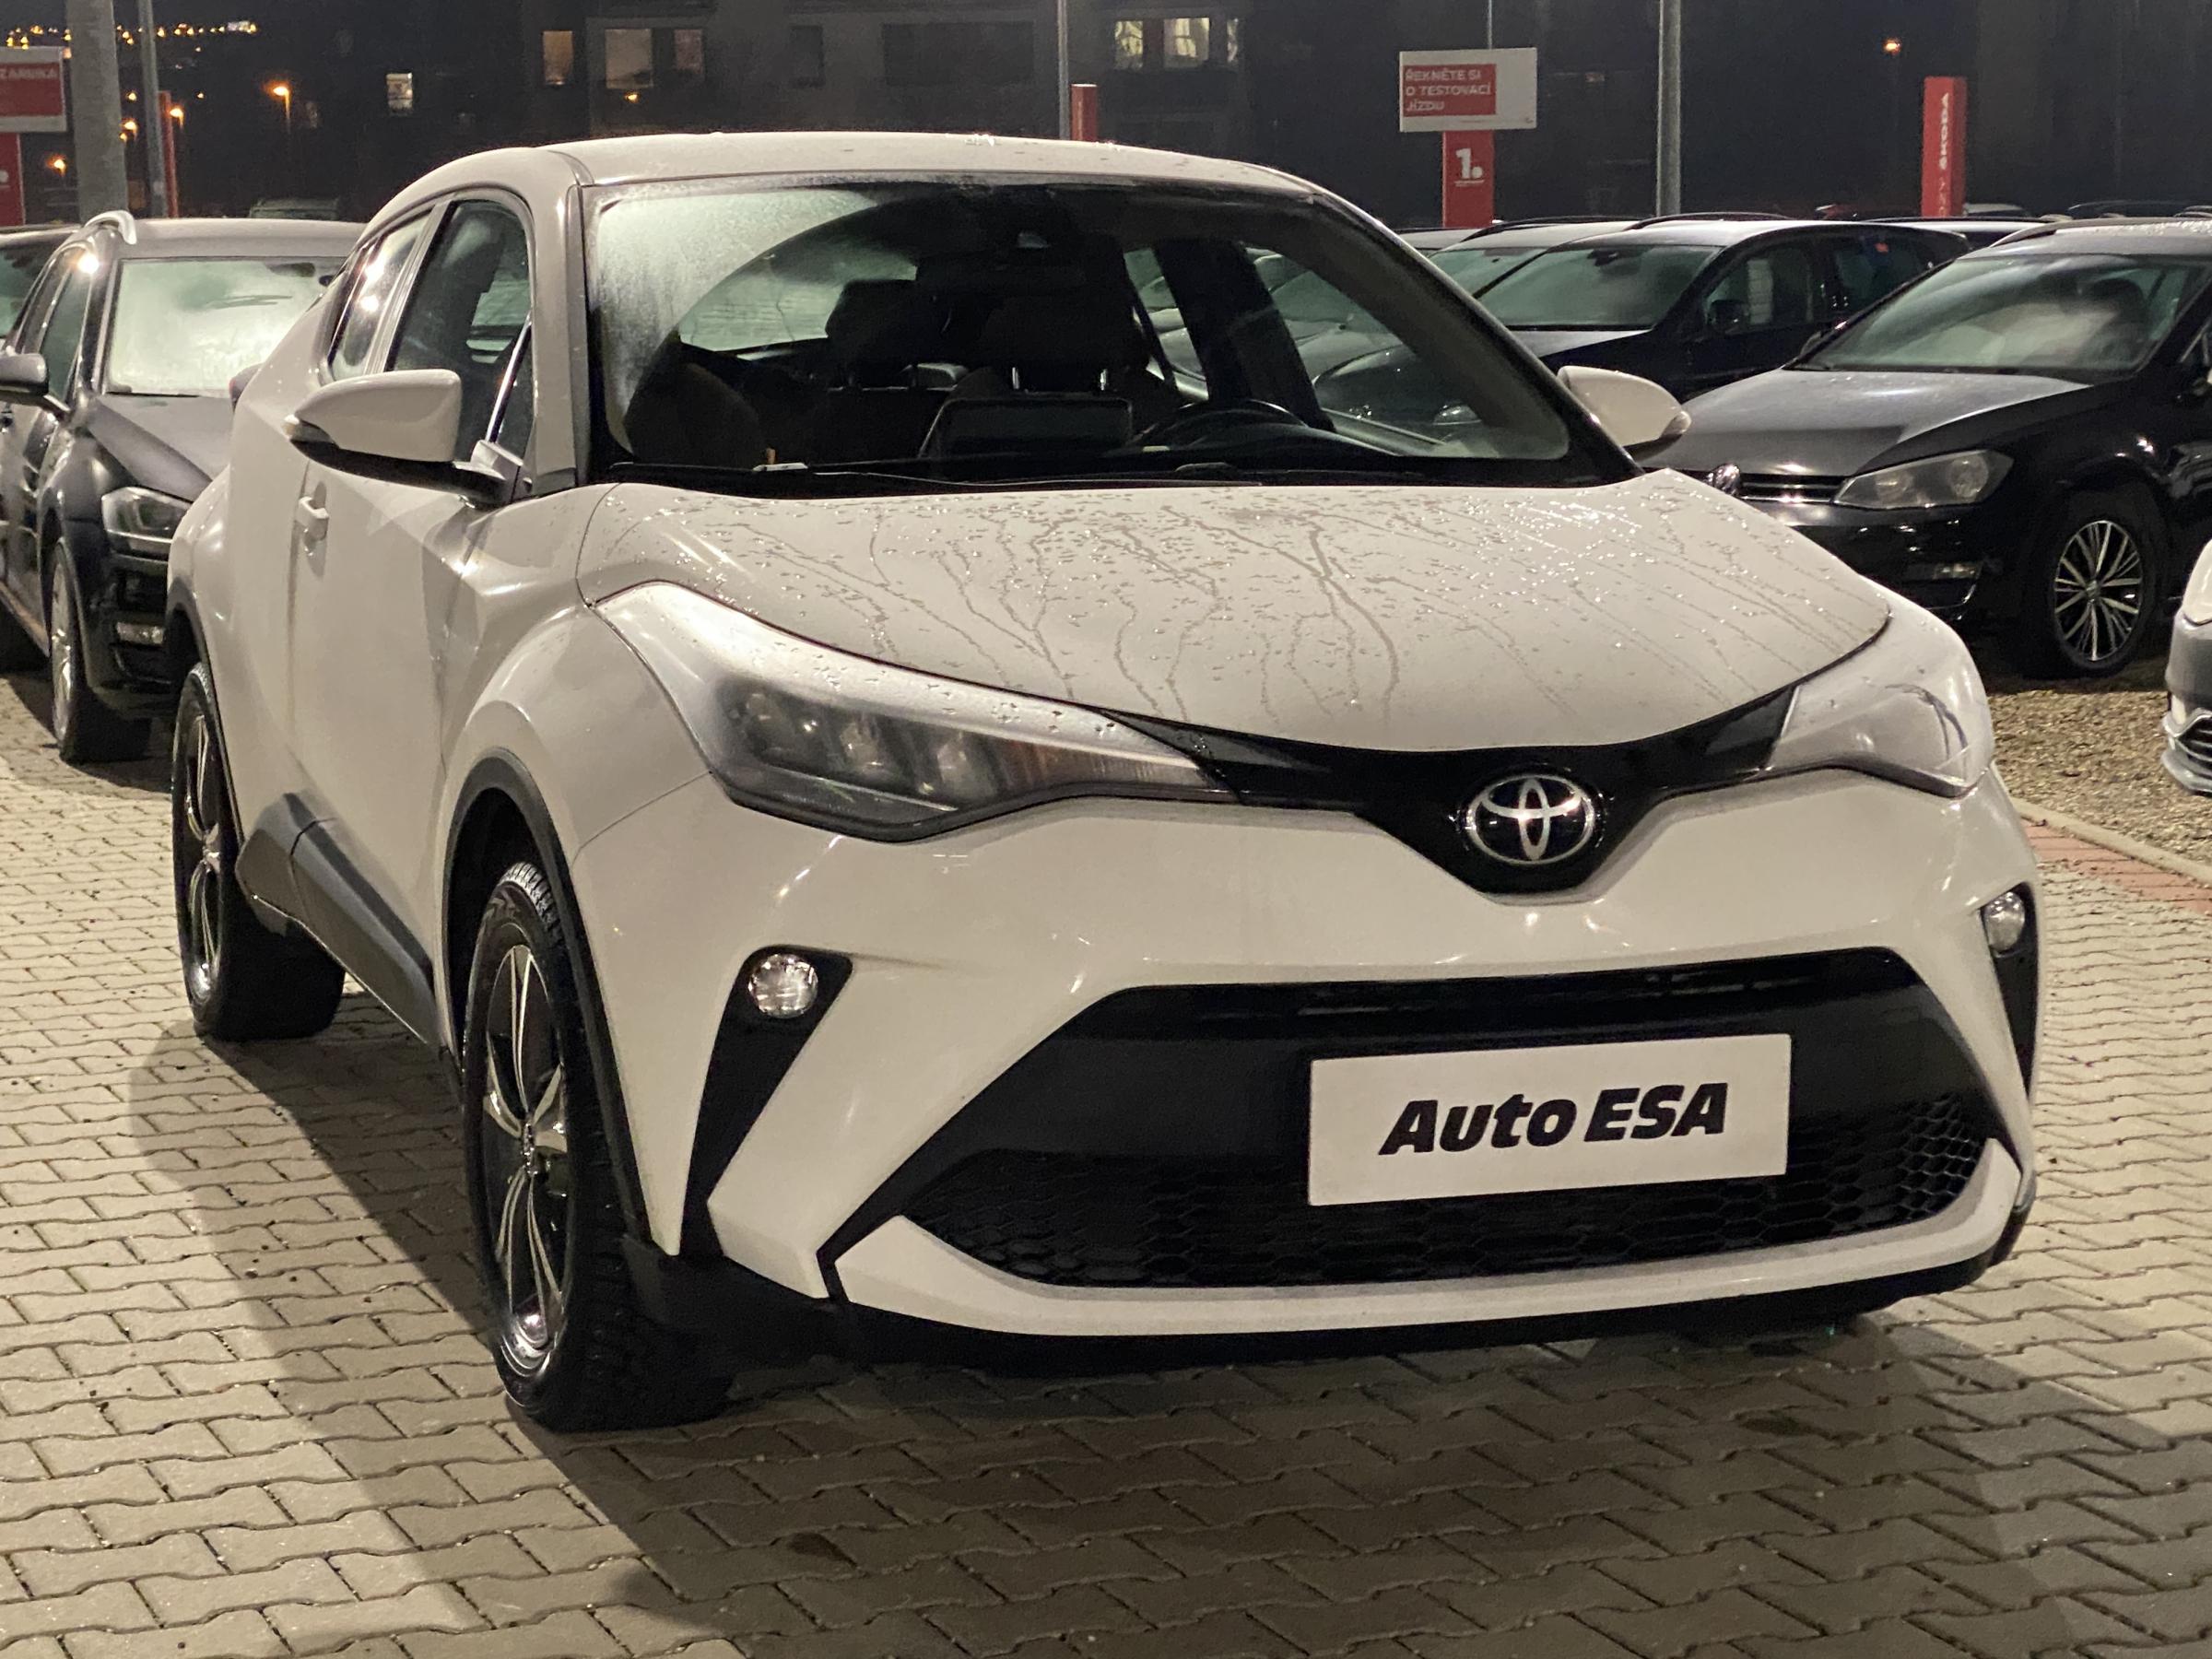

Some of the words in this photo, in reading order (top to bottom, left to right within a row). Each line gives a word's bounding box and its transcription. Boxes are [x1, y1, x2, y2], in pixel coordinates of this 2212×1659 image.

[1468, 69, 1480, 80] SI
[1406, 86, 1415, 96] O
[1419, 83, 1489, 96] TESTOVACÍ
[1455, 148, 1483, 179] 1.
[1378, 1093, 1577, 1156] Auto
[1583, 1082, 1728, 1143] ESA
